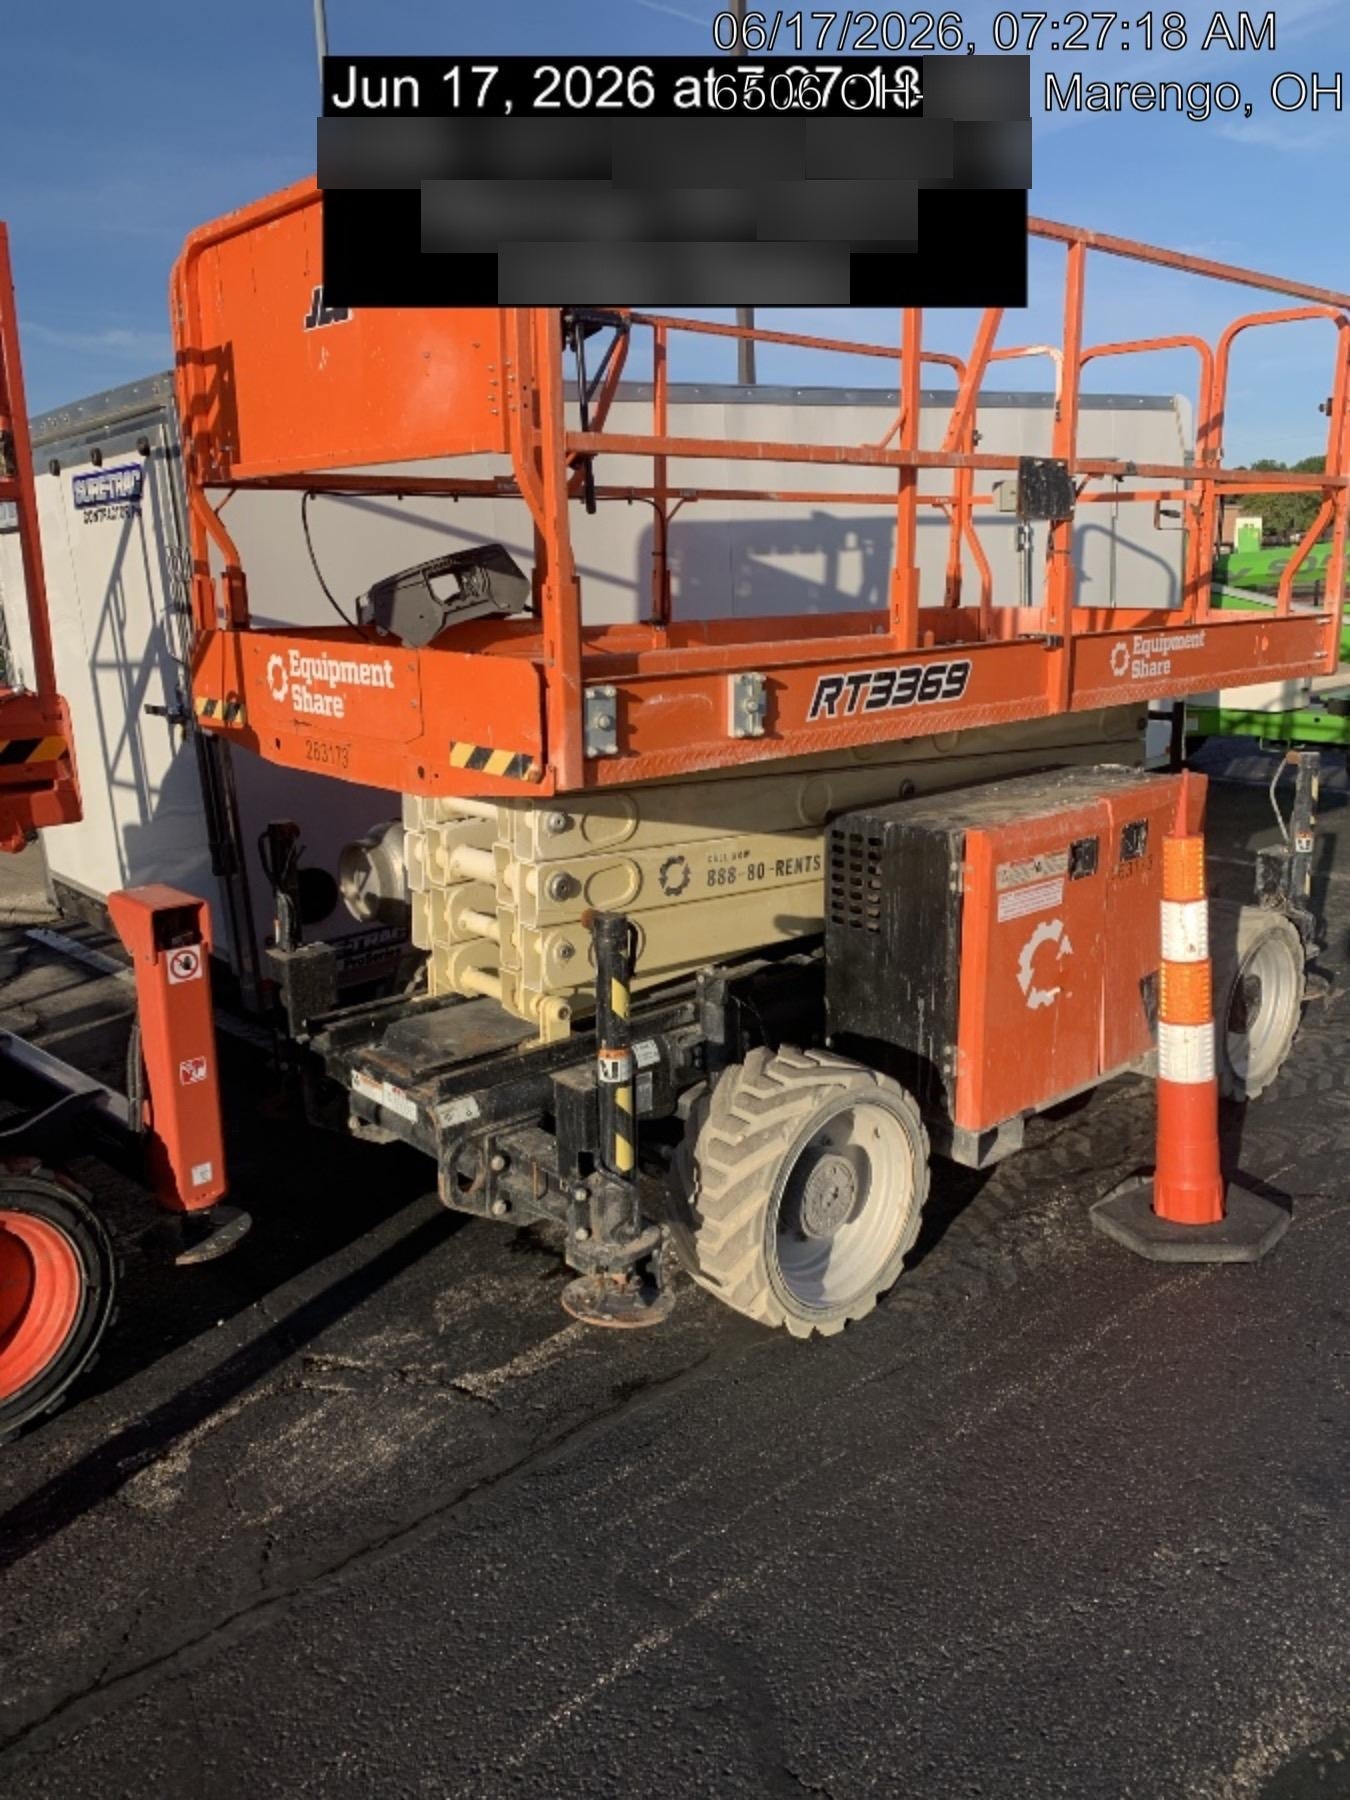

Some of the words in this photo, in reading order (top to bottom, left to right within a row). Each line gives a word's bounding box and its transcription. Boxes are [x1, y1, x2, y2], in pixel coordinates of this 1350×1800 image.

[1132, 629, 1206, 659] Equipment
[288, 649, 395, 688] Equipment
[1131, 657, 1171, 679] Share
[292, 685, 345, 718] Share
[807, 659, 972, 722] RT3369
